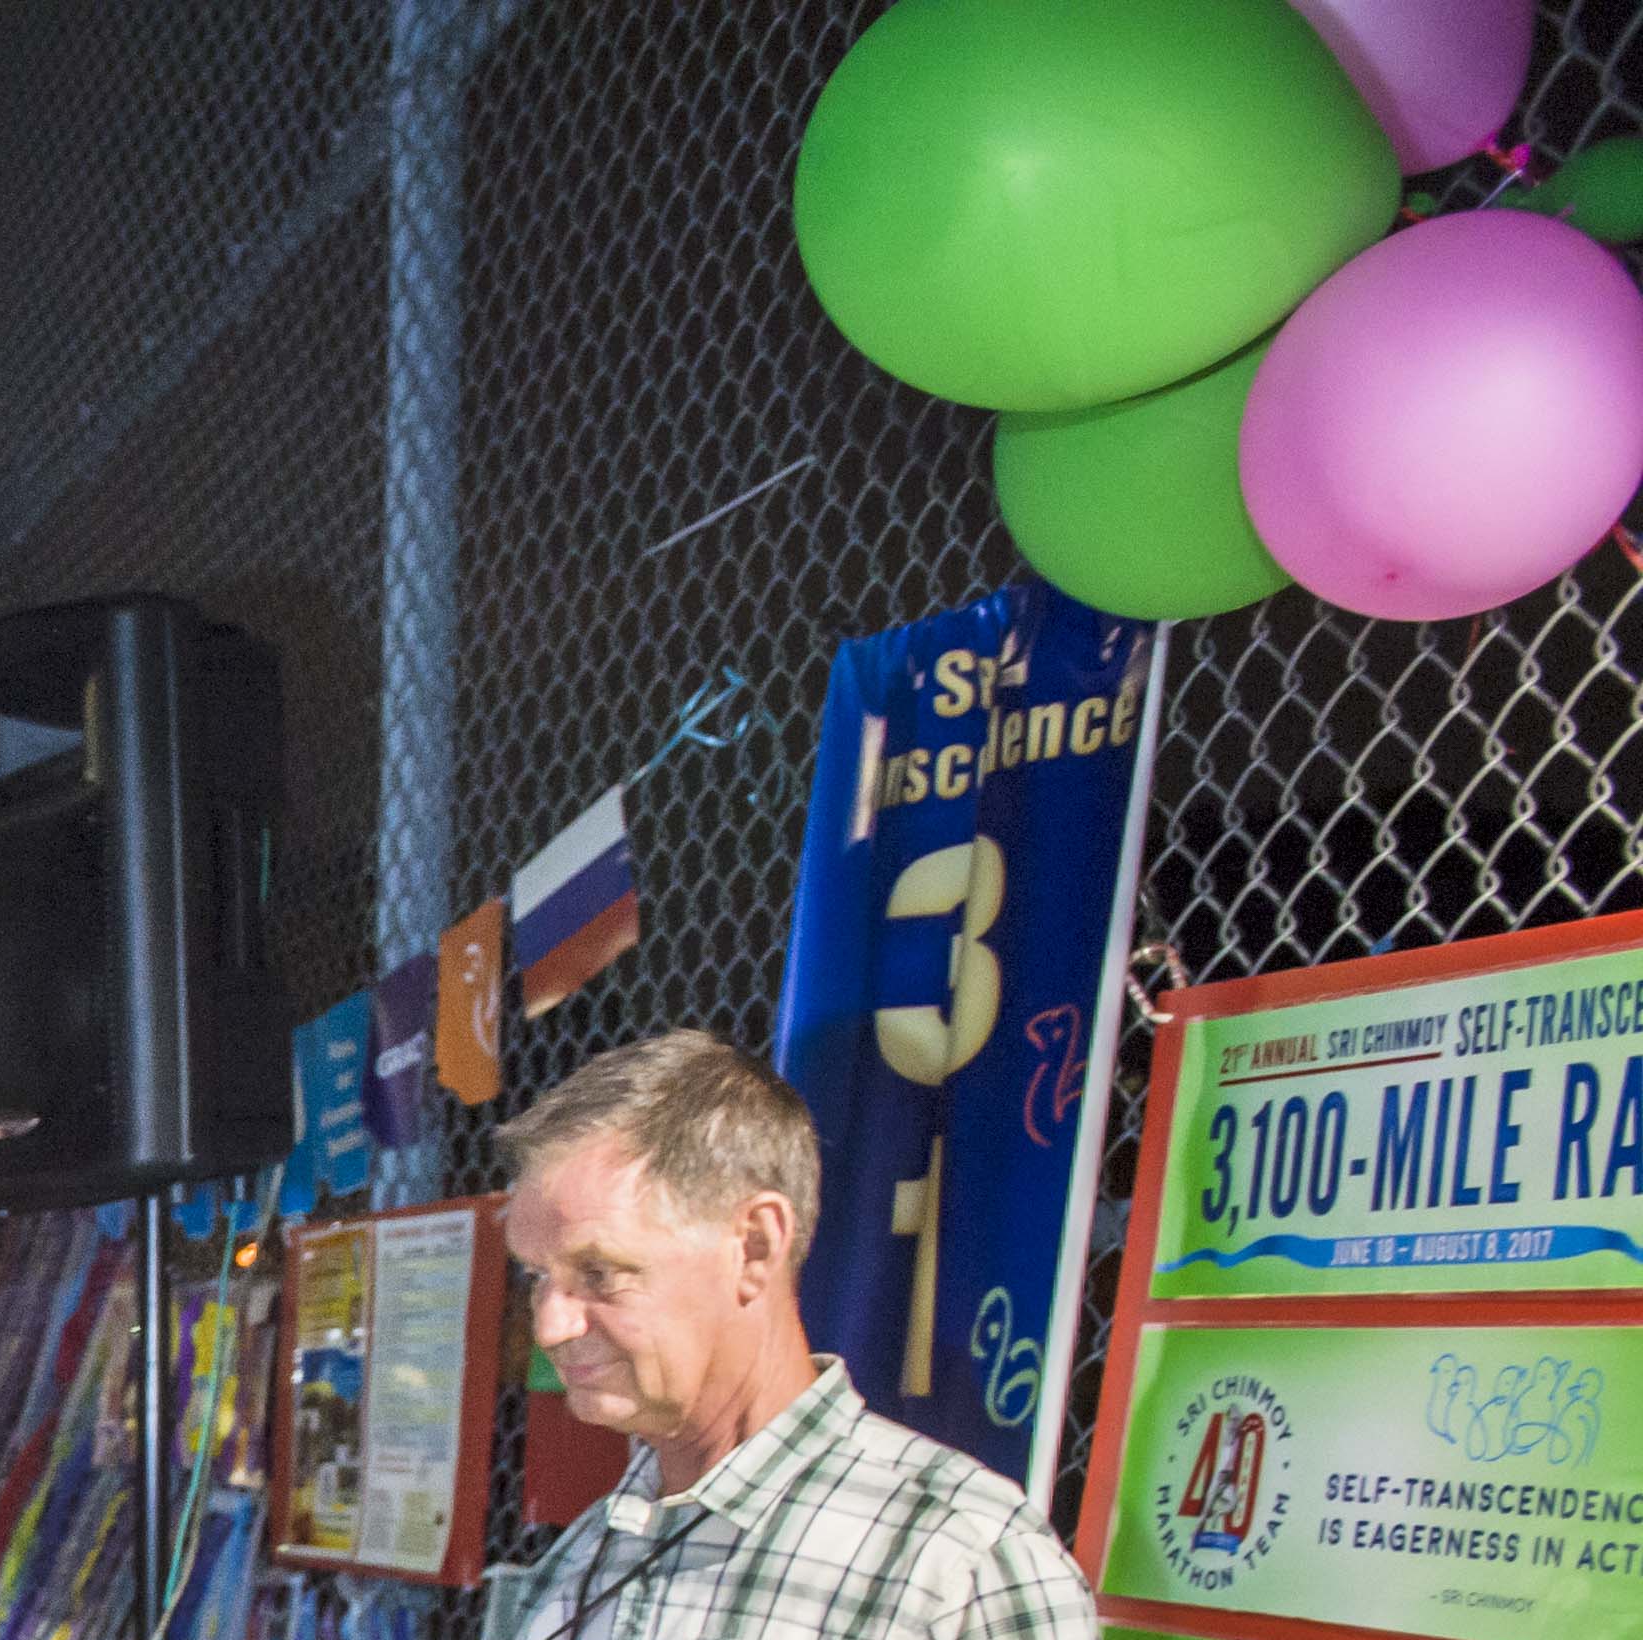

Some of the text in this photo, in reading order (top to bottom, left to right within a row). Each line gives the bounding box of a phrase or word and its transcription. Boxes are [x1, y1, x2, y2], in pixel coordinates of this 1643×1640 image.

[1251, 1035, 1318, 1070] ANNUAL
[1327, 1030, 1356, 1060] SRI
[1362, 1013, 1449, 1054] CHINMOY
[1201, 1068, 1531, 1237] 3,100-MILE
[1330, 1236, 1372, 1265] JUNE
[1413, 1233, 1481, 1263] AUGUST
[1508, 1230, 1555, 1258] 2017
[1176, 1376, 1292, 1441] SRI CHINMOY
[1178, 1411, 1266, 1542] 40
[1325, 1473, 1643, 1524] SELF-TRANSCENDENC
[1157, 1484, 1290, 1590] MARATHON TEAM
[1318, 1518, 1342, 1545] IS
[1353, 1519, 1519, 1562] EAGERNESS
[1532, 1536, 1564, 1567] IN
[1466, 1591, 1537, 1613] CHINMOY
